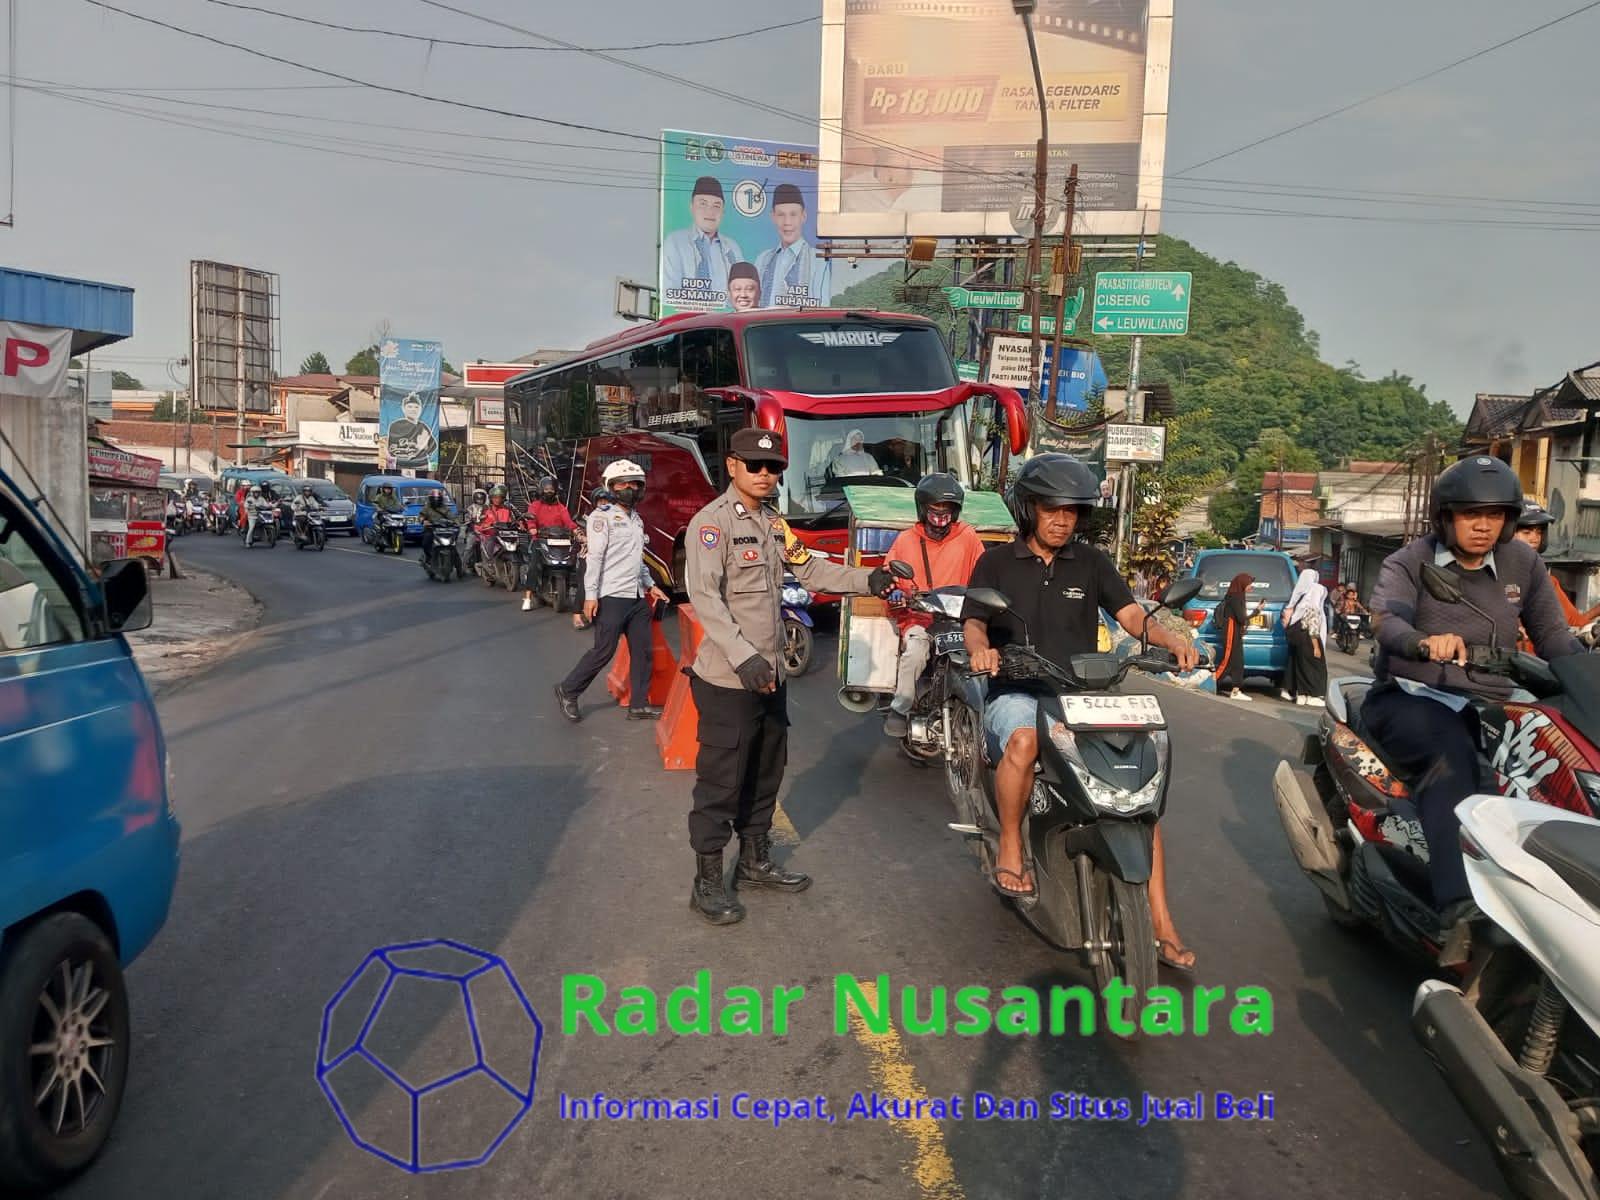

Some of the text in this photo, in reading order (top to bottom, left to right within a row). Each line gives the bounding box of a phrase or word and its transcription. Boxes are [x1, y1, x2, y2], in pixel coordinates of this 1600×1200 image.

[867, 64, 904, 75] BARU
[1002, 84, 1121, 97] RASA EGENDARIS
[1015, 98, 1101, 110] TANA FILTER
[681, 278, 712, 289] RUDY
[666, 289, 726, 301] SUSMANTO
[788, 285, 808, 296] ADE
[775, 296, 820, 307] RUHANDI
[969, 292, 1023, 306] leuwiliang
[1097, 294, 1151, 306] CISEENG
[1117, 318, 1184, 330] LEUWILIANG
[823, 331, 883, 346] MARVEL
[0, 337, 50, 377] P
[1010, 374, 1033, 383] MURA
